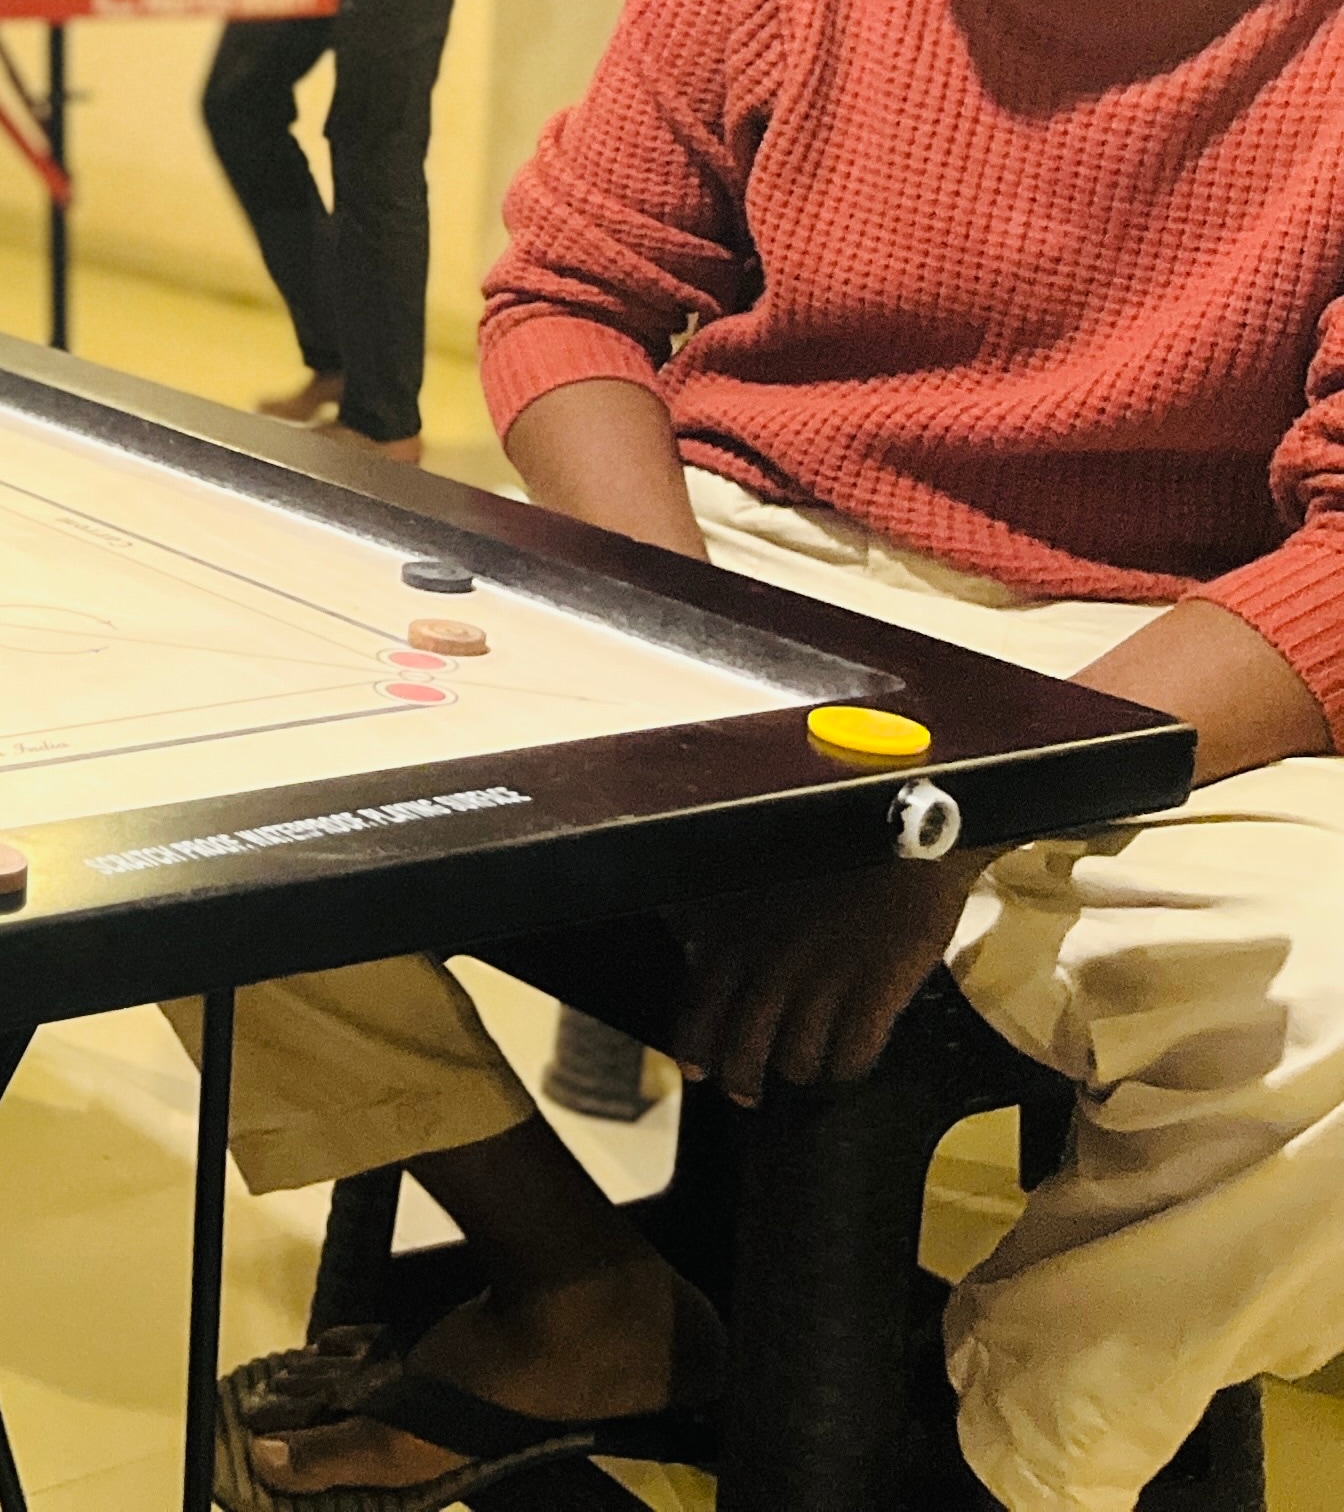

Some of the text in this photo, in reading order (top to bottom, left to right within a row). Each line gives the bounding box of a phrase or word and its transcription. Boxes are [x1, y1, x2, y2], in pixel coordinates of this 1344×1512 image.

[13, 740, 70, 755] India
[83, 844, 188, 875] SCRATCH
[357, 799, 452, 825] PLAYING
